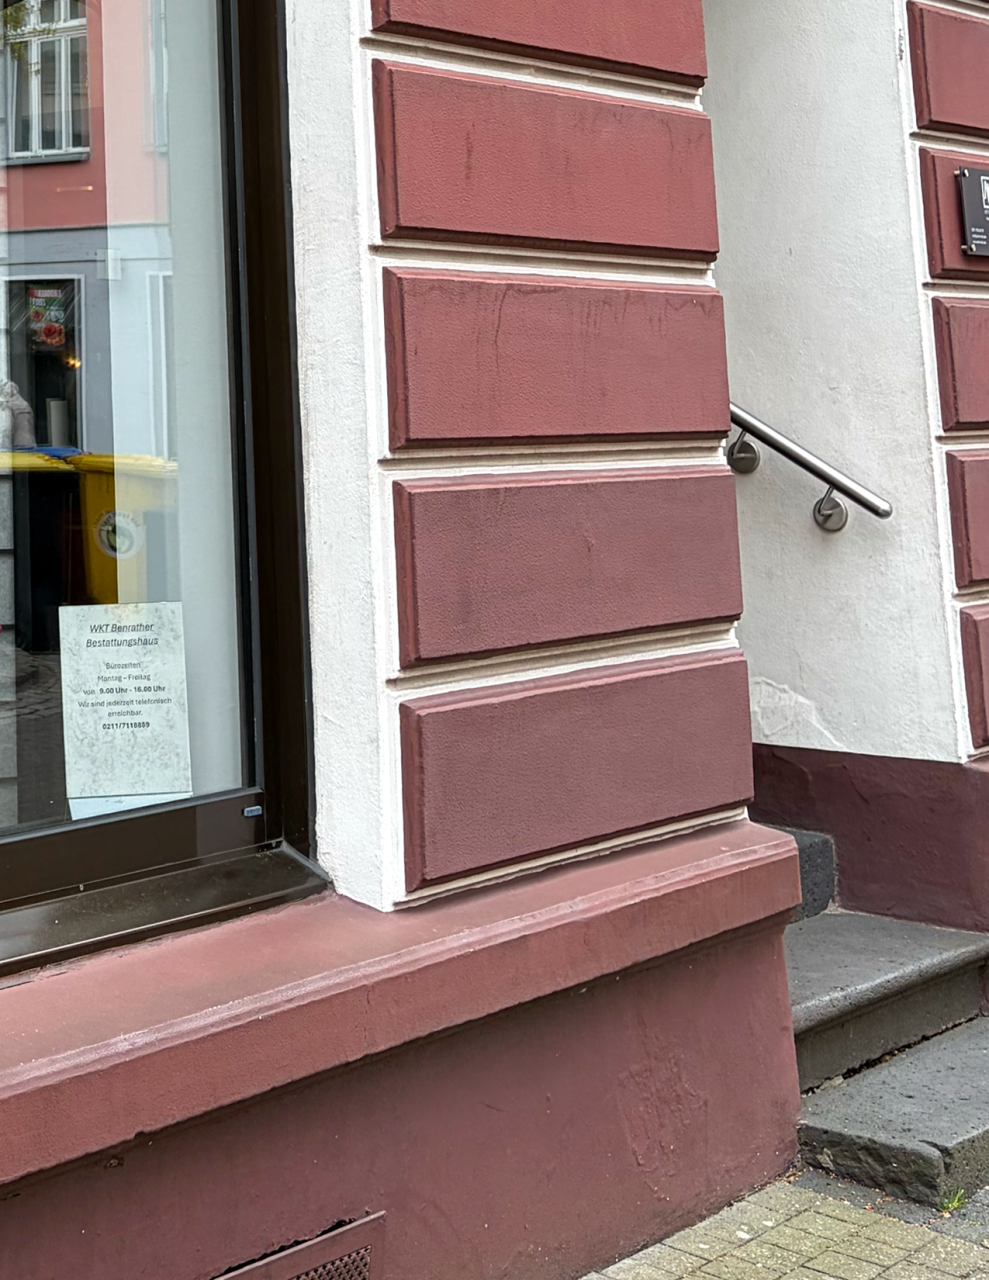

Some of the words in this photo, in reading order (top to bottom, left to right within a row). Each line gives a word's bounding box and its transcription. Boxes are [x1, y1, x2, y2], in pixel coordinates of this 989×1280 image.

[90, 624, 110, 634] WKT
[110, 623, 155, 634] Benrather
[86, 637, 159, 648] Bestattungshaus
[105, 662, 142, 670] Bürozeiten
[97, 674, 123, 682] Montag
[128, 673, 152, 682] Freitag
[99, 687, 115, 695] 9.00
[77, 700, 90, 708] Wir
[106, 699, 135, 708] jederzeit
[135, 697, 173, 706] telefonisch
